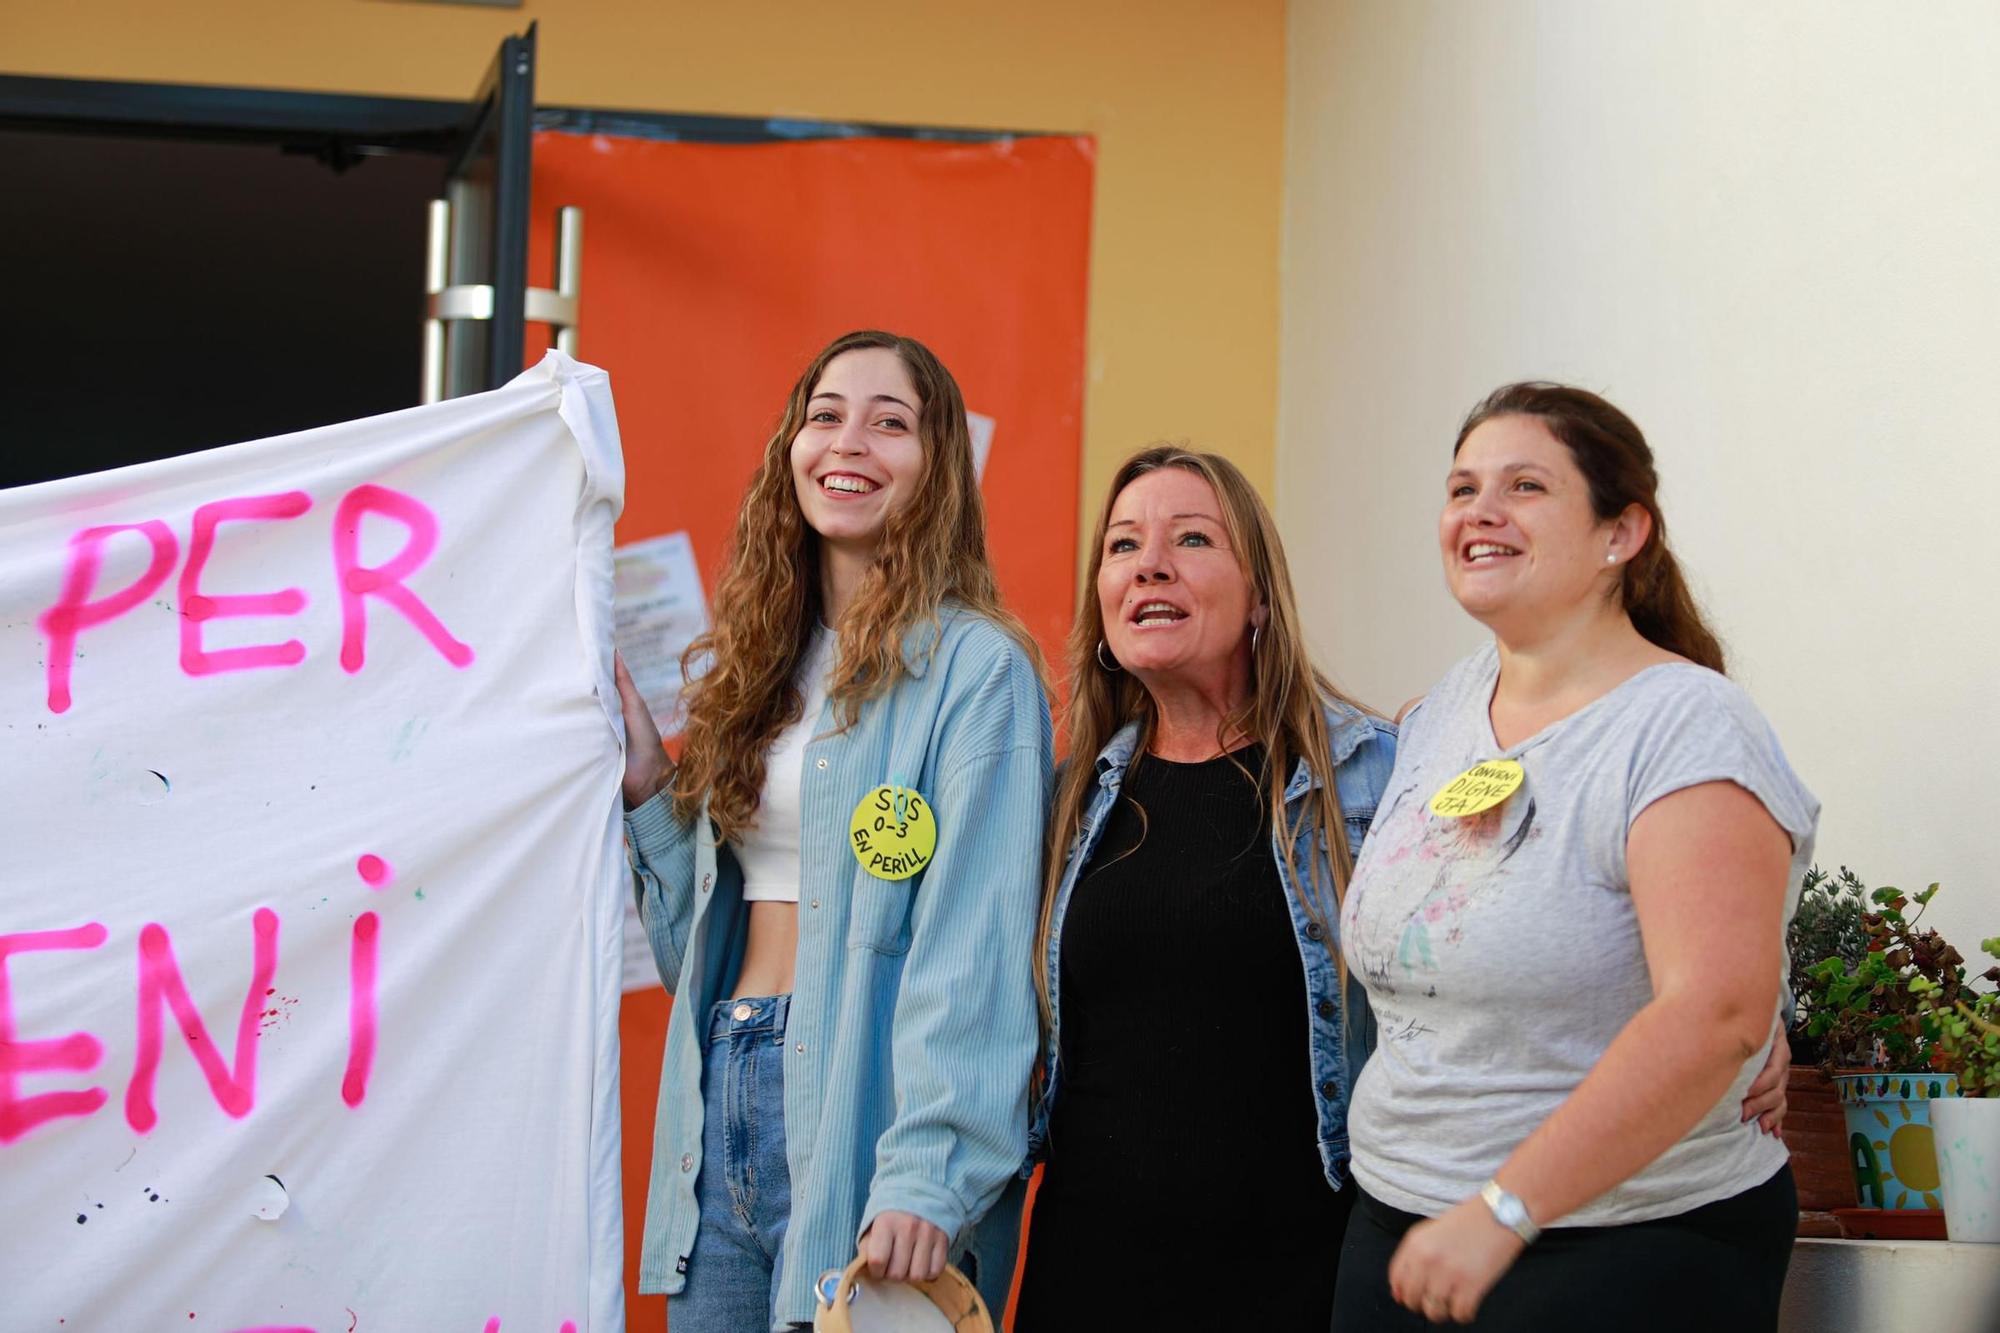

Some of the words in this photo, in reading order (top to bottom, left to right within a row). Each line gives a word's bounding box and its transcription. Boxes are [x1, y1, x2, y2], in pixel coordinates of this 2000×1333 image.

[37, 483, 475, 713] PER
[1446, 778, 1511, 797] DIGNE
[853, 828, 873, 854] EN
